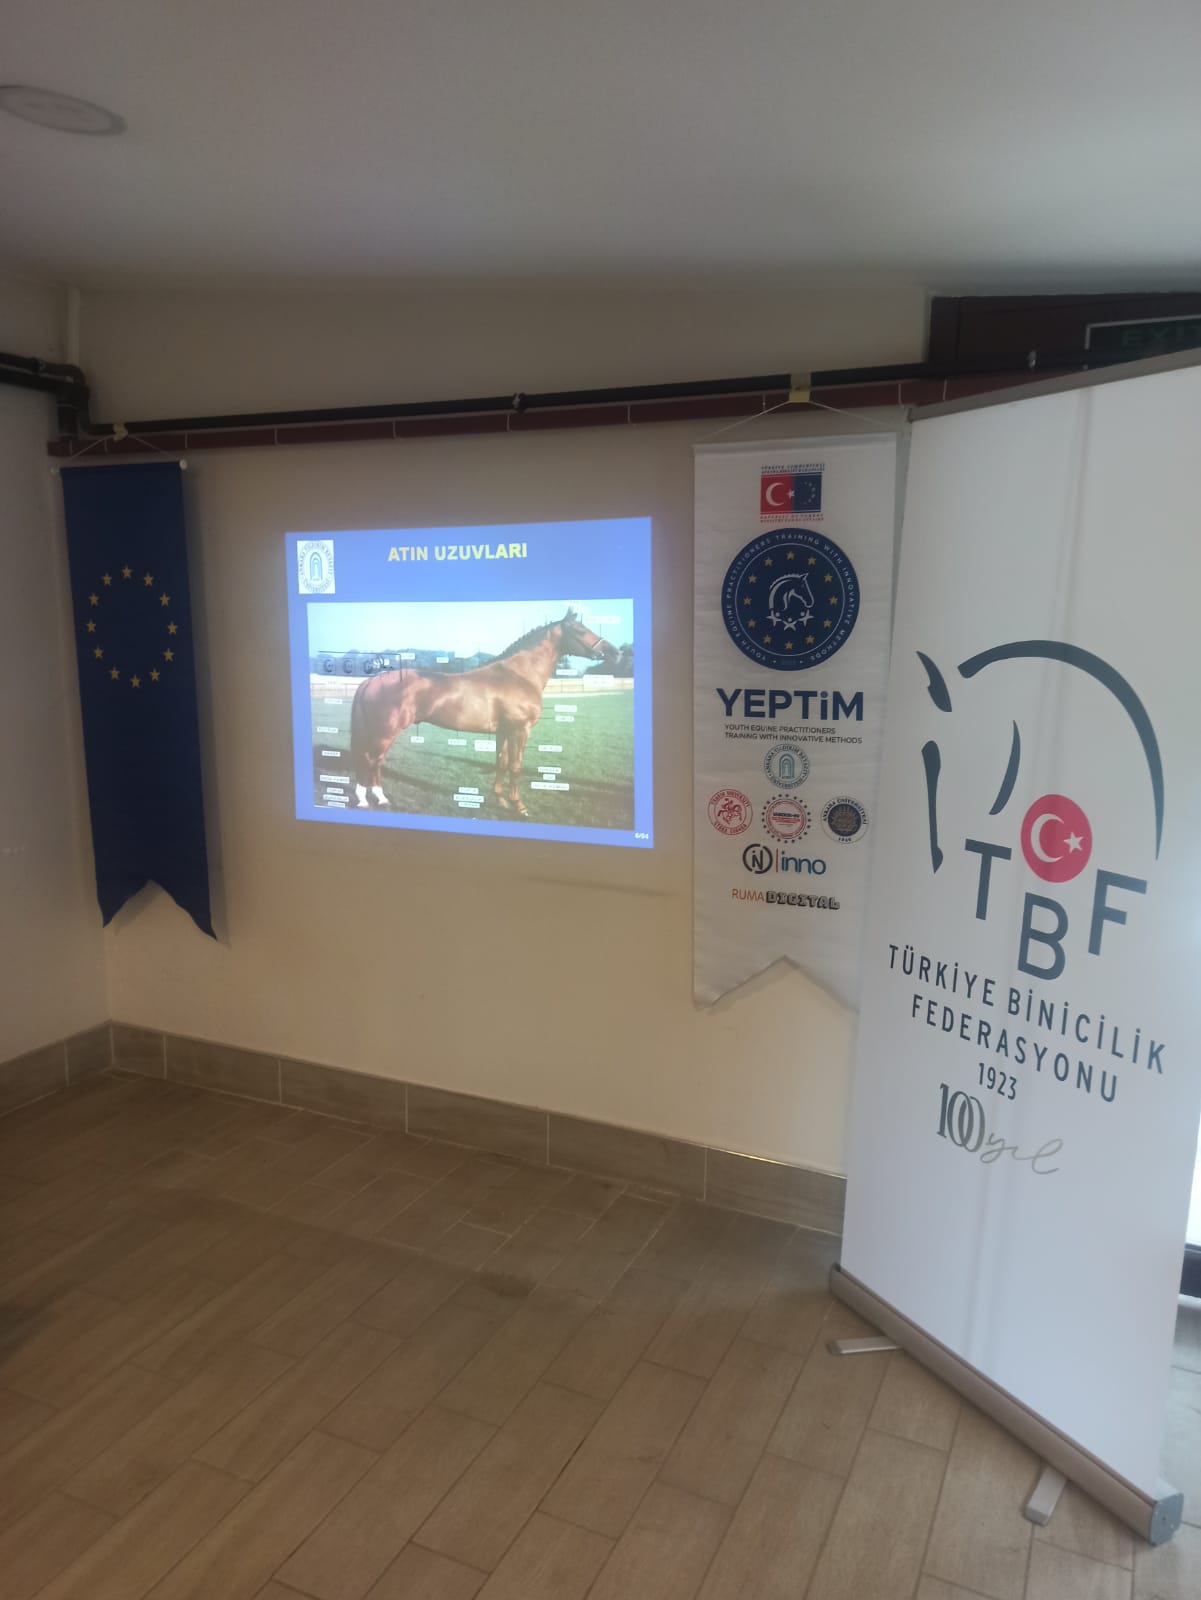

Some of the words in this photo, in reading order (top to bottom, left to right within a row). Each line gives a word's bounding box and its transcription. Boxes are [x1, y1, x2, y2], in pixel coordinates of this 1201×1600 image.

[388, 546, 429, 562] ATIN
[434, 543, 528, 560] UZUVLARI
[775, 534, 820, 546] TRAINING
[823, 544, 843, 564] WITH
[726, 538, 771, 598] PRACTITIONERS
[842, 566, 857, 624] INNOVATIVE
[727, 604, 741, 638] EQUINE
[741, 640, 767, 662] YOUTH
[810, 630, 846, 661] METHODS
[725, 724, 750, 732] YOUTH
[779, 726, 836, 734] PRACTITIONERS
[725, 732, 758, 740] TRAINING
[779, 734, 824, 743] INNOVATIVE
[825, 736, 863, 744] METHODS
[781, 850, 826, 875] inno
[732, 888, 764, 902] RUMA
[766, 891, 840, 910] DIGITAL
[888, 943, 996, 1007] TÜRKİYE
[1007, 988, 1166, 1074] BİNİCİLİK
[911, 994, 1118, 1103] FEDERASYONU
[978, 1062, 1018, 1100] 1923
[936, 1082, 986, 1154] 100
